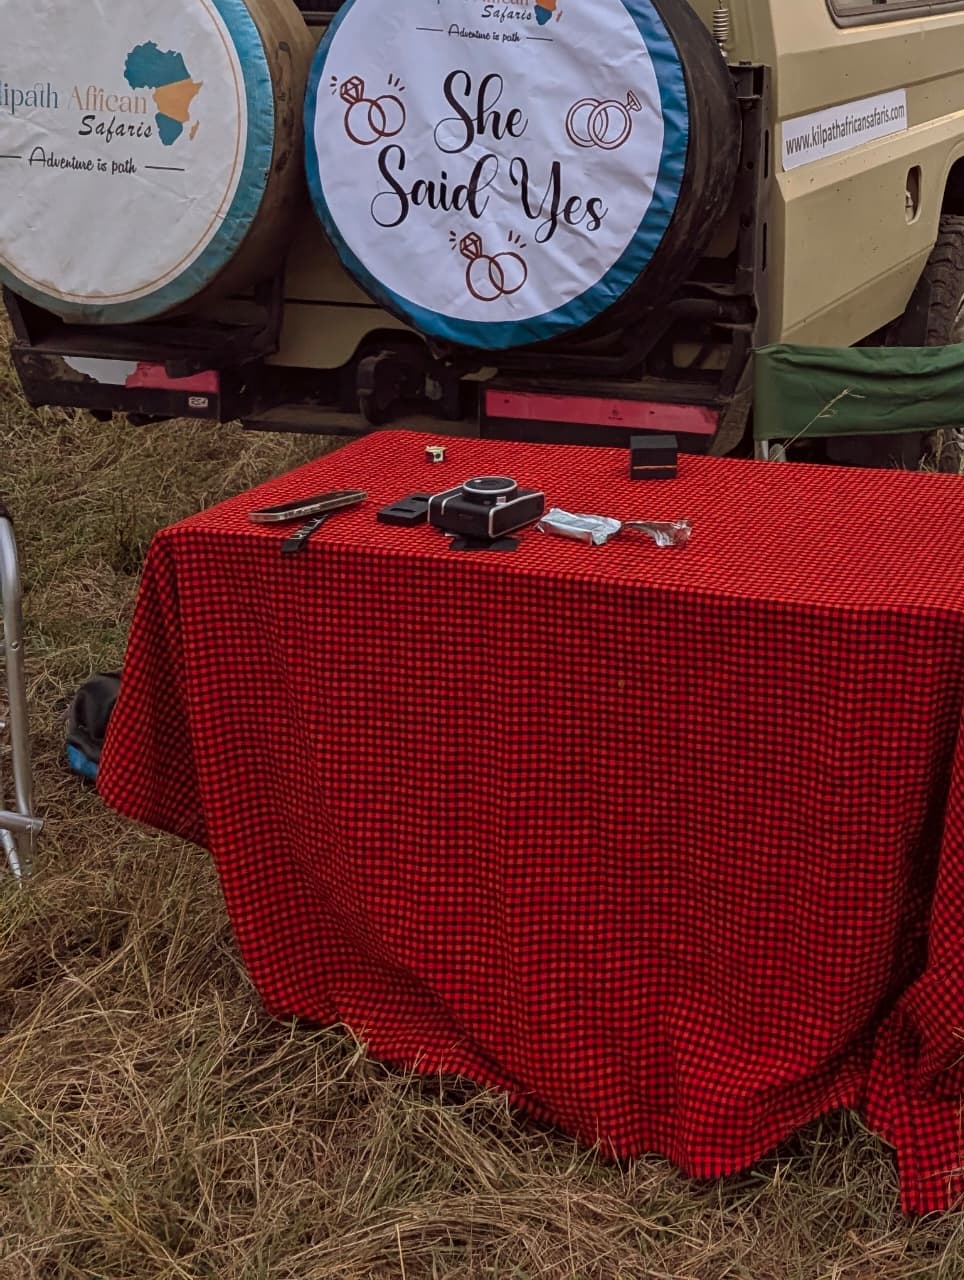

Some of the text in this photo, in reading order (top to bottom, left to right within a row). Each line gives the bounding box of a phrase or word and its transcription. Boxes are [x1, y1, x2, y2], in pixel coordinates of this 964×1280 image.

[481, 4, 532, 23] Safaris
[448, 23, 521, 43] Adventure is path
[70, 85, 147, 114] African
[433, 69, 528, 154] She
[78, 114, 153, 143] Safaris
[28, 146, 137, 175] Adventure is path
[370, 144, 609, 245] Said Yes
